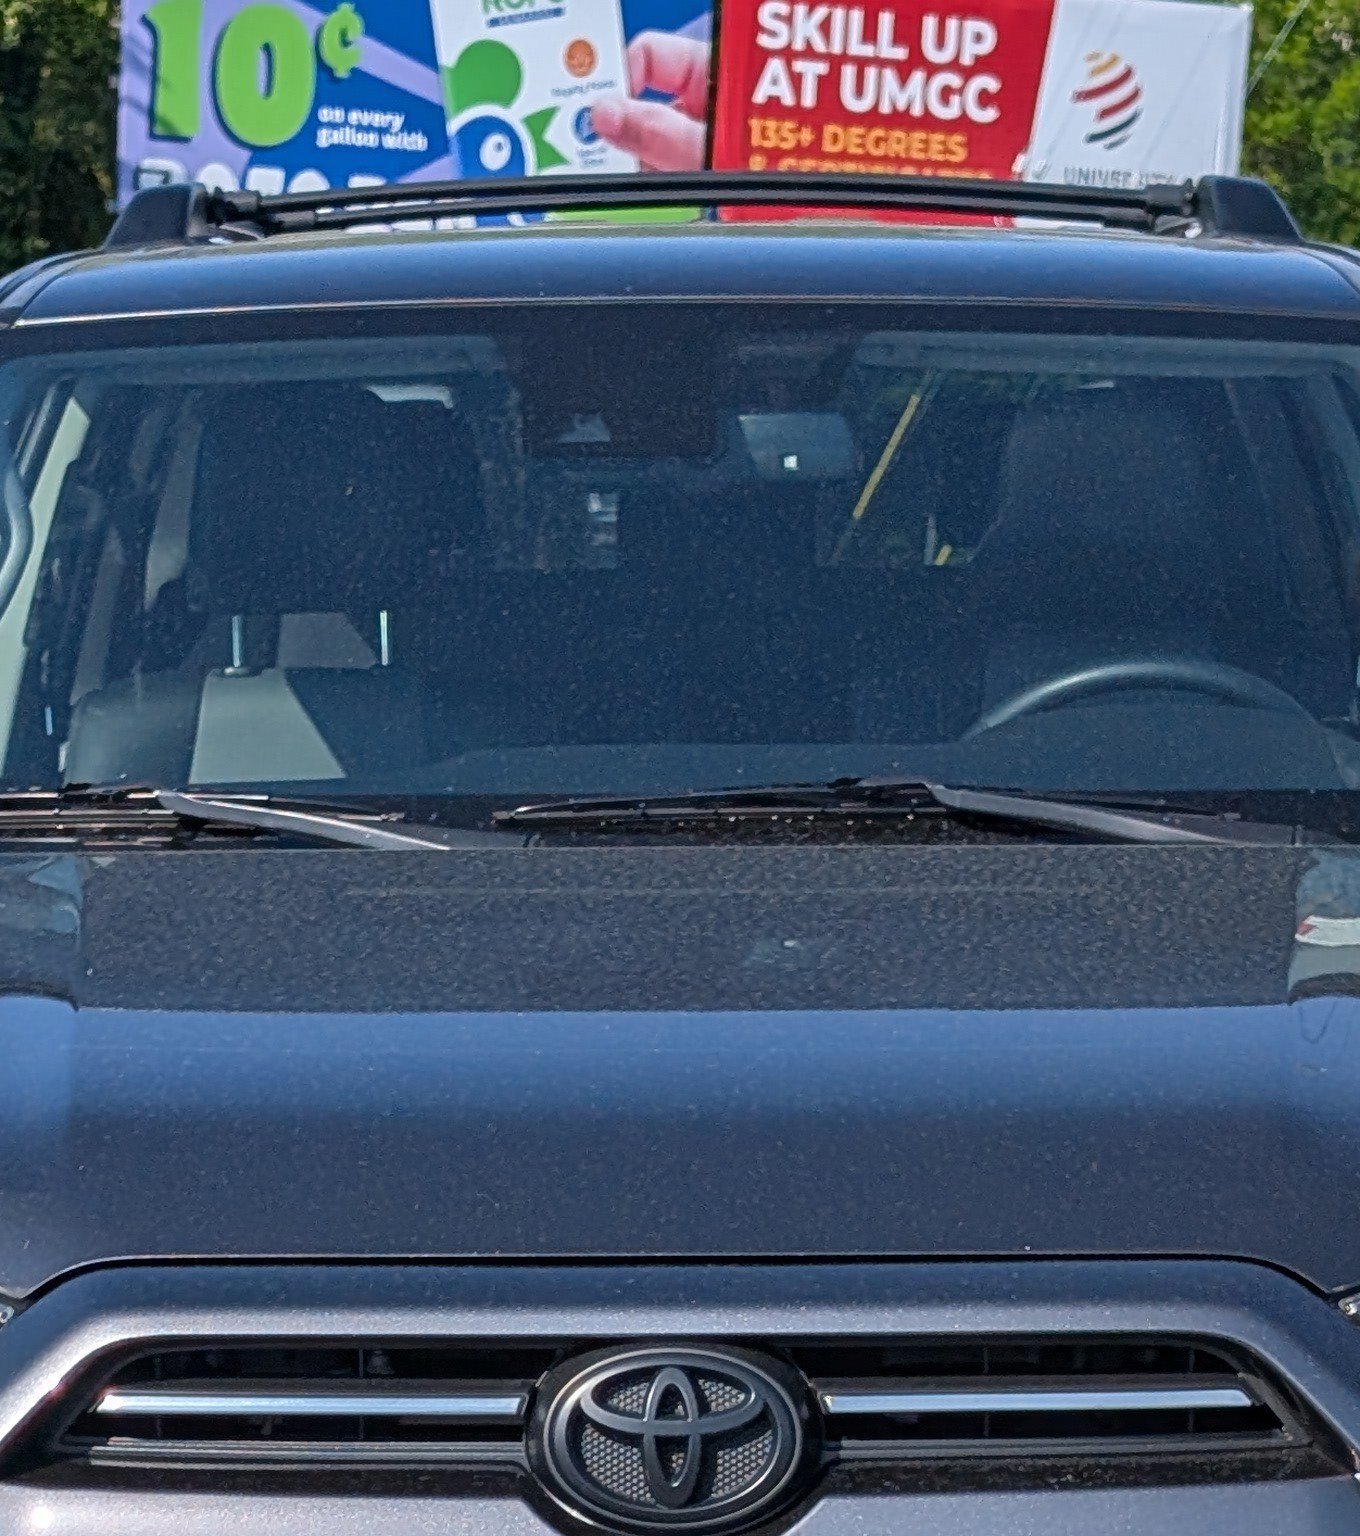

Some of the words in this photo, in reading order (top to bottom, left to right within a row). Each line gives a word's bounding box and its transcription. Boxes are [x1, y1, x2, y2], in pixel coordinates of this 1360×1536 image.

[755, 0, 909, 62] SKILL
[921, 13, 998, 66] UP
[752, 58, 829, 109] AT
[839, 63, 1002, 125] UMGC
[316, 126, 379, 148] gallon
[381, 131, 428, 152] with
[348, 108, 405, 133] every
[748, 116, 816, 151] 135+
[820, 123, 969, 164] DEGREES
